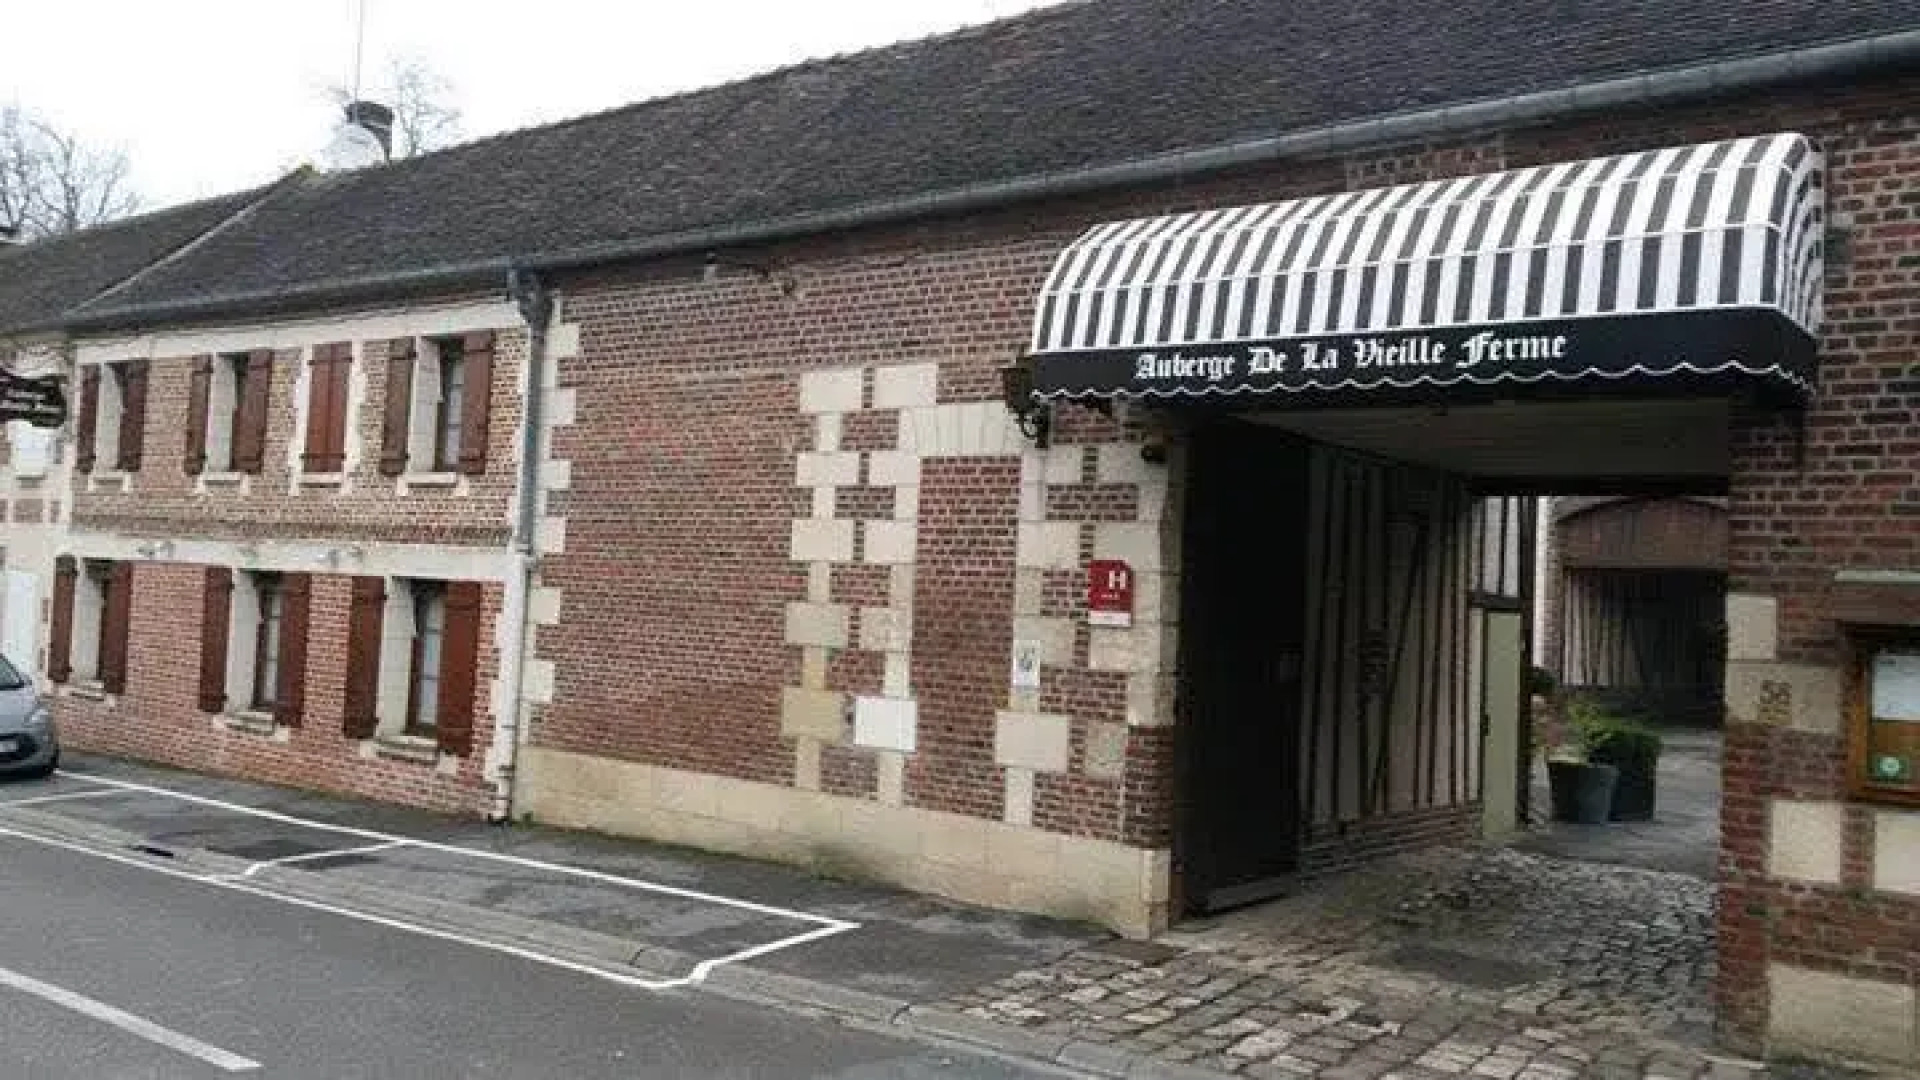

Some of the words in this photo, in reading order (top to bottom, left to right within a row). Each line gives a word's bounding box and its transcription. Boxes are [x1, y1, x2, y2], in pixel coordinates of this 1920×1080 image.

[1134, 351, 1235, 381] Auberge
[1248, 346, 1288, 375] De
[1300, 342, 1339, 371] La
[1354, 336, 1446, 368] Vieille
[1455, 331, 1566, 368] Ferme
[1108, 570, 1126, 590] H
